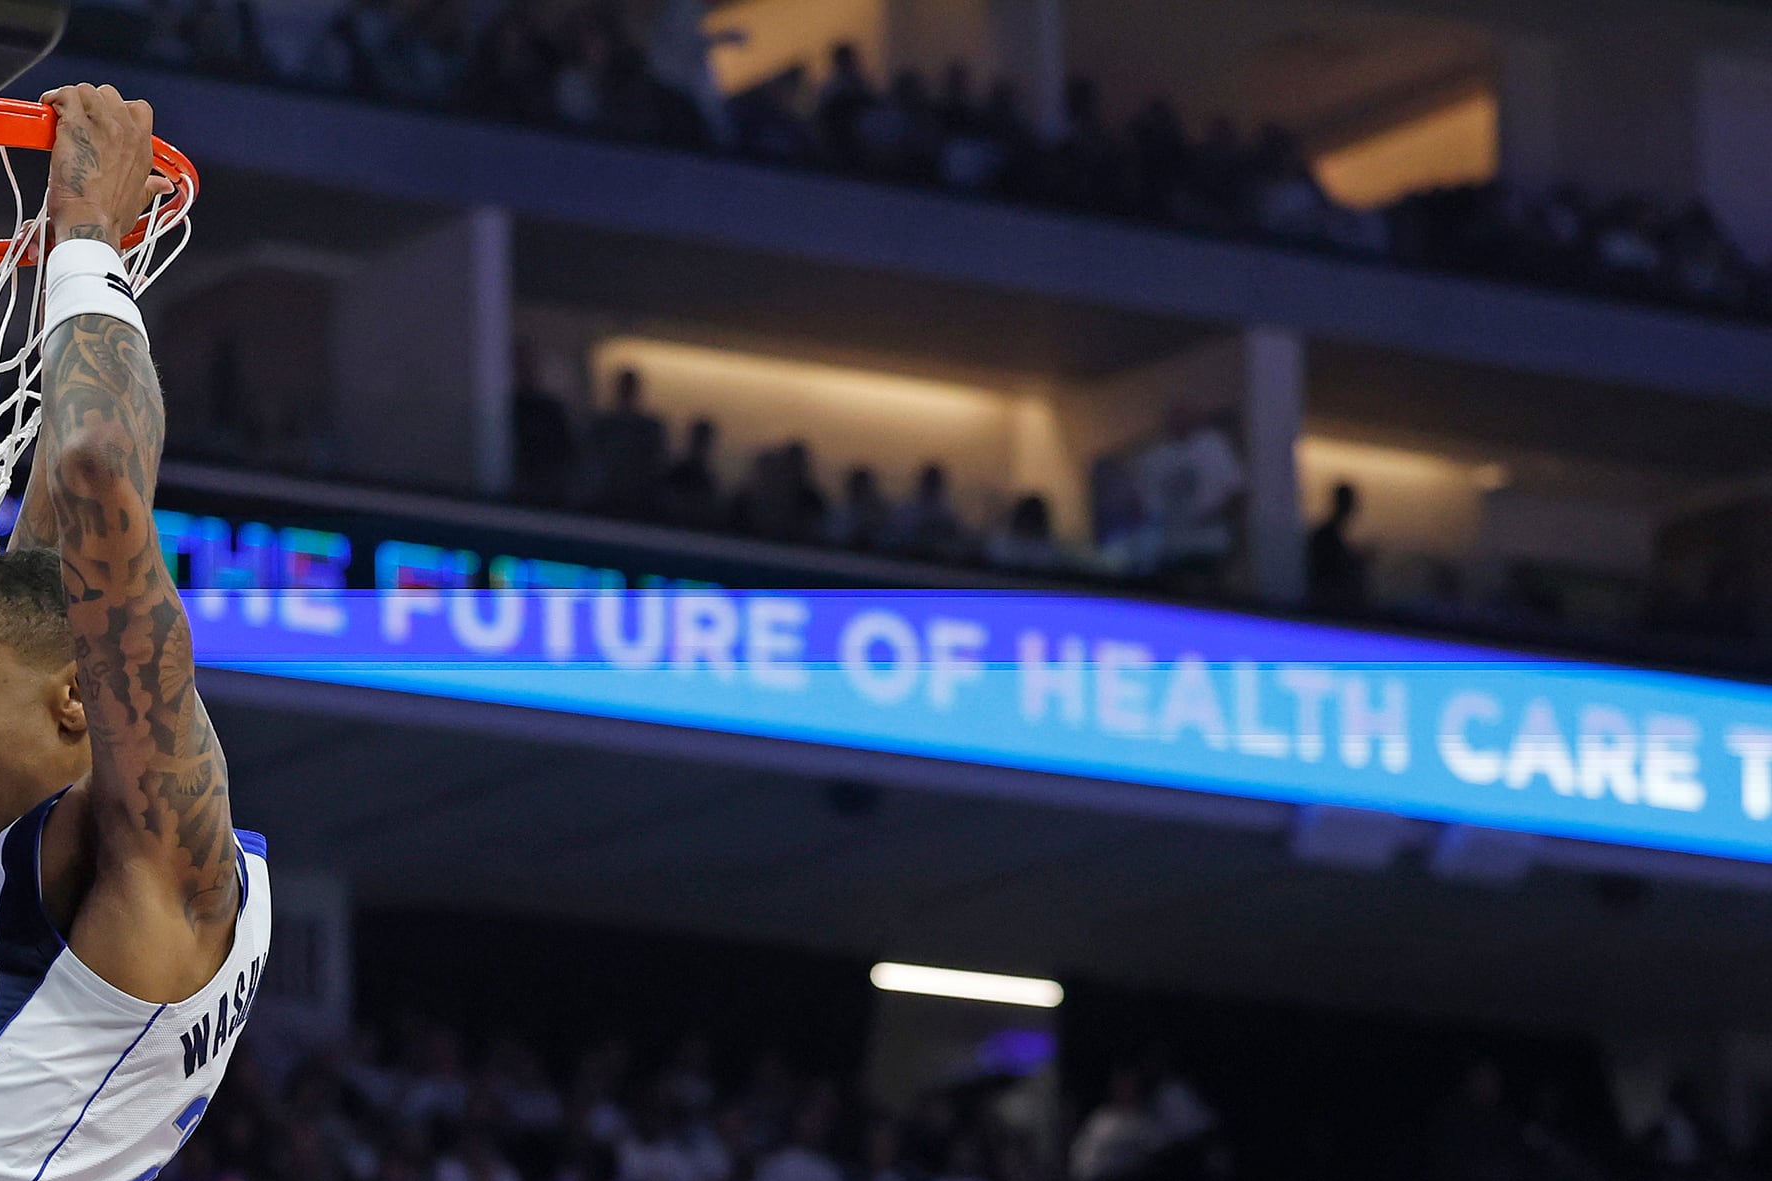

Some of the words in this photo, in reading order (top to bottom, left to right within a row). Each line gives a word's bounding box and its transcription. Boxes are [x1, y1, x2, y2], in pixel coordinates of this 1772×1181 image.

[374, 539, 815, 692] FUTURE
[837, 608, 989, 713] OF
[1017, 629, 1411, 774] HEALTH
[1439, 690, 1706, 813] CARE
